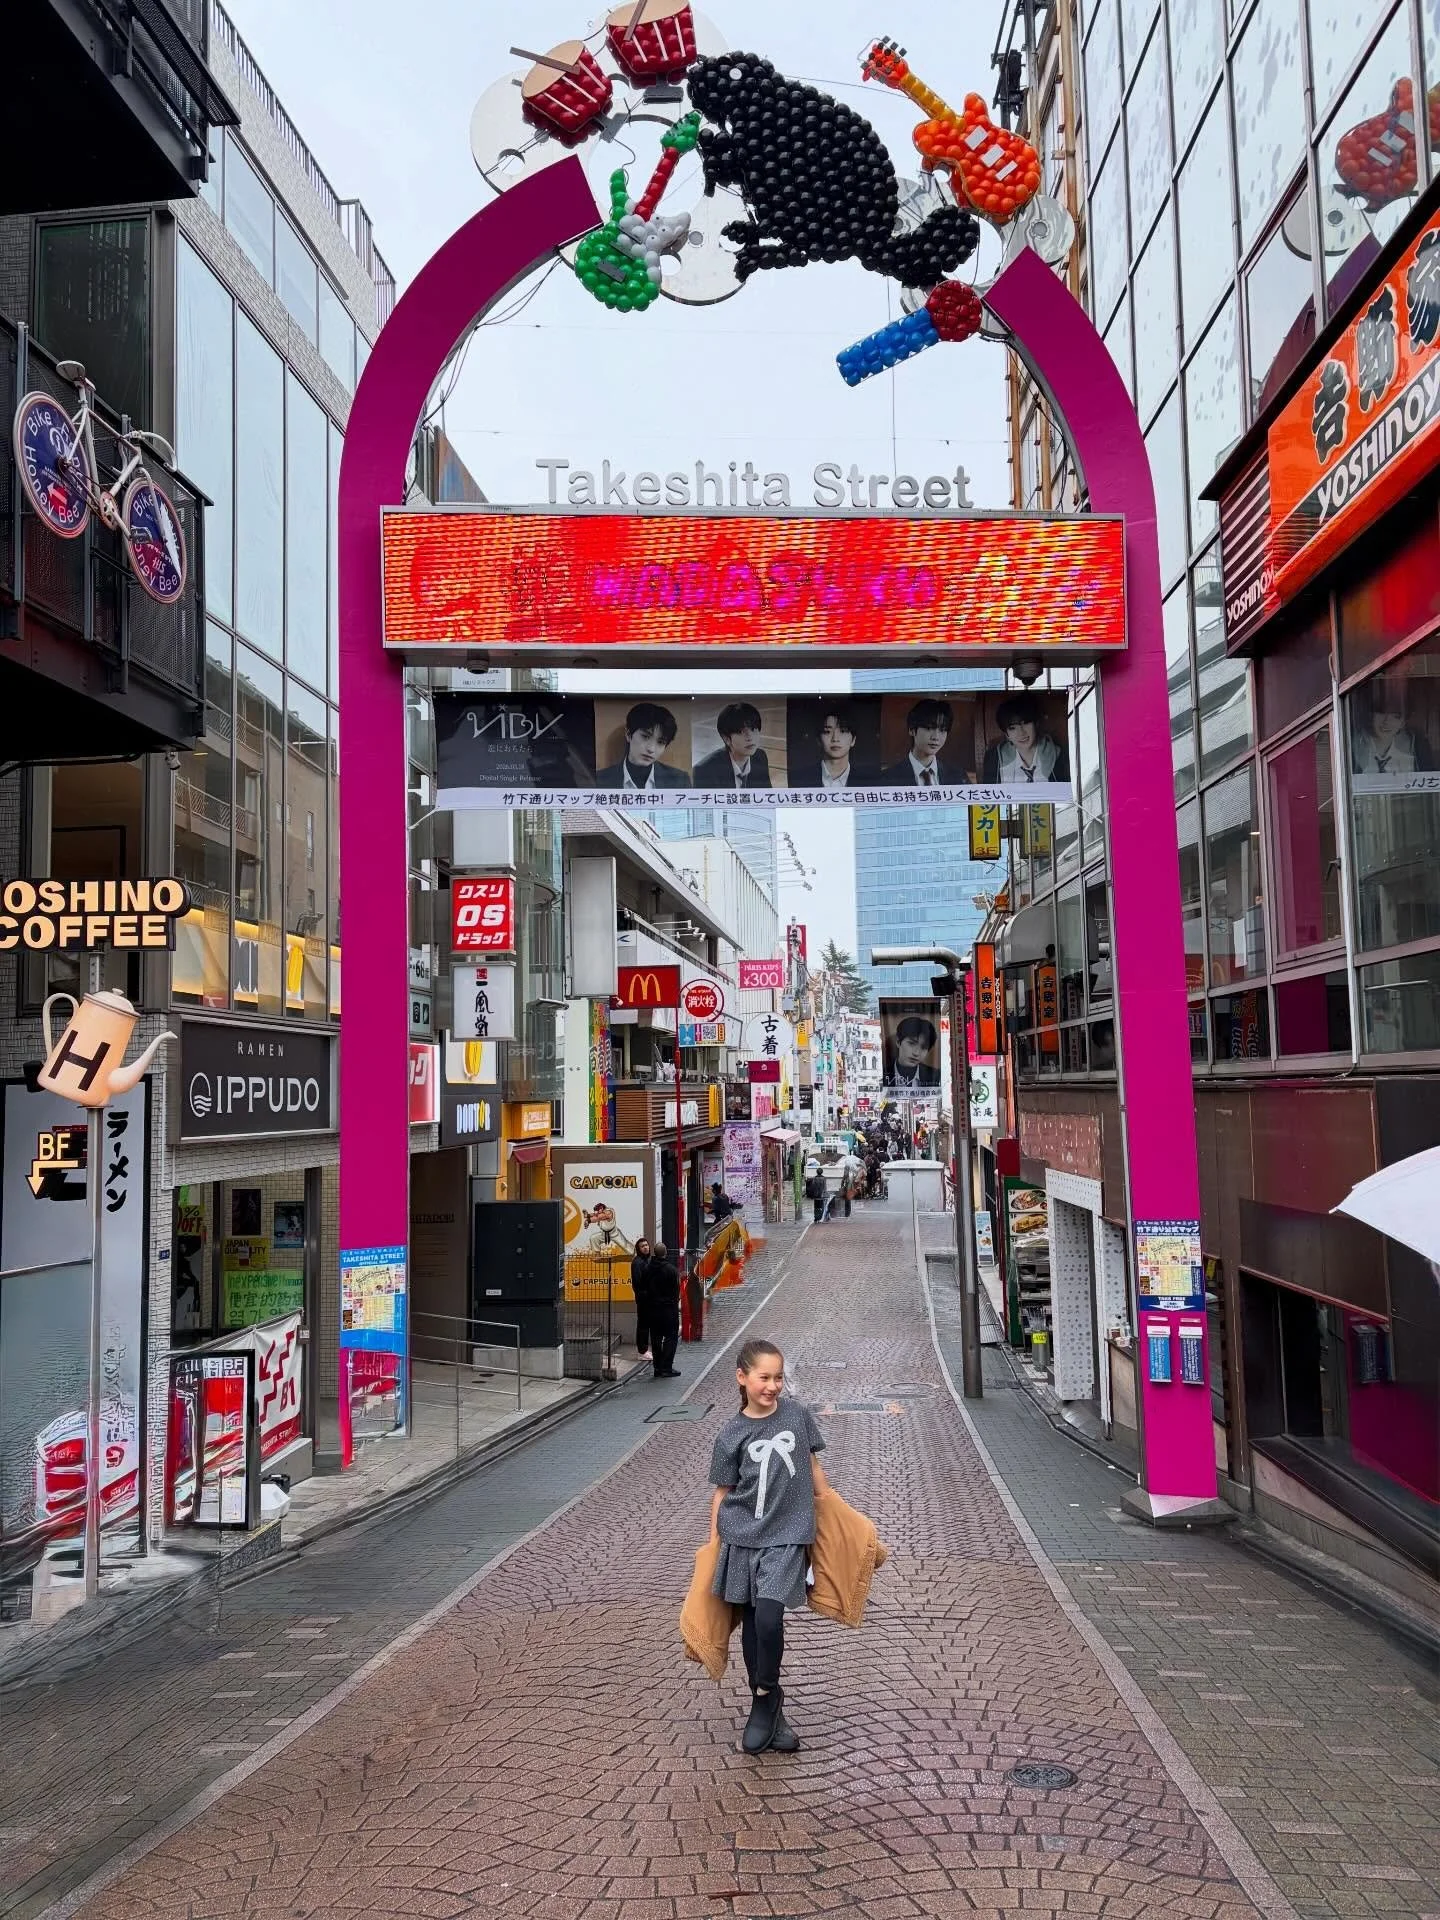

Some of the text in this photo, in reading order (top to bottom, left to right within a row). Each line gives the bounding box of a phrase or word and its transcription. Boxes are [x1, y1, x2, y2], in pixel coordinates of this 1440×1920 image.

[26, 408, 52, 436] Bike
[24, 445, 54, 517] Honey
[58, 500, 80, 524] Bee
[536, 459, 974, 508] Takeshita Street
[159, 574, 178, 591] Bee
[502, 792, 664, 806] 竹下通りマップ絶賛配布中!
[975, 847, 997, 856] 3F
[458, 884, 504, 899] クスリ
[456, 904, 506, 927] OS
[0, 915, 167, 949] COFFEE
[456, 932, 508, 945] ドラッグ
[744, 972, 779, 987] ¥300
[687, 995, 716, 1008] 消火栓
[981, 976, 993, 1019] 吉野家
[761, 1015, 779, 1055] 古着
[48, 1029, 111, 1091] H
[237, 1041, 284, 1057] RAMEN
[216, 1075, 320, 1114] IPPUDO
[39, 1133, 71, 1160] BF
[105, 1111, 129, 1213] ラーメン
[570, 1175, 638, 1189] CAPCOM
[343, 1252, 405, 1263] TAKESHITA STREET
[223, 1358, 244, 1370] BF
[279, 1376, 296, 1413] B1
